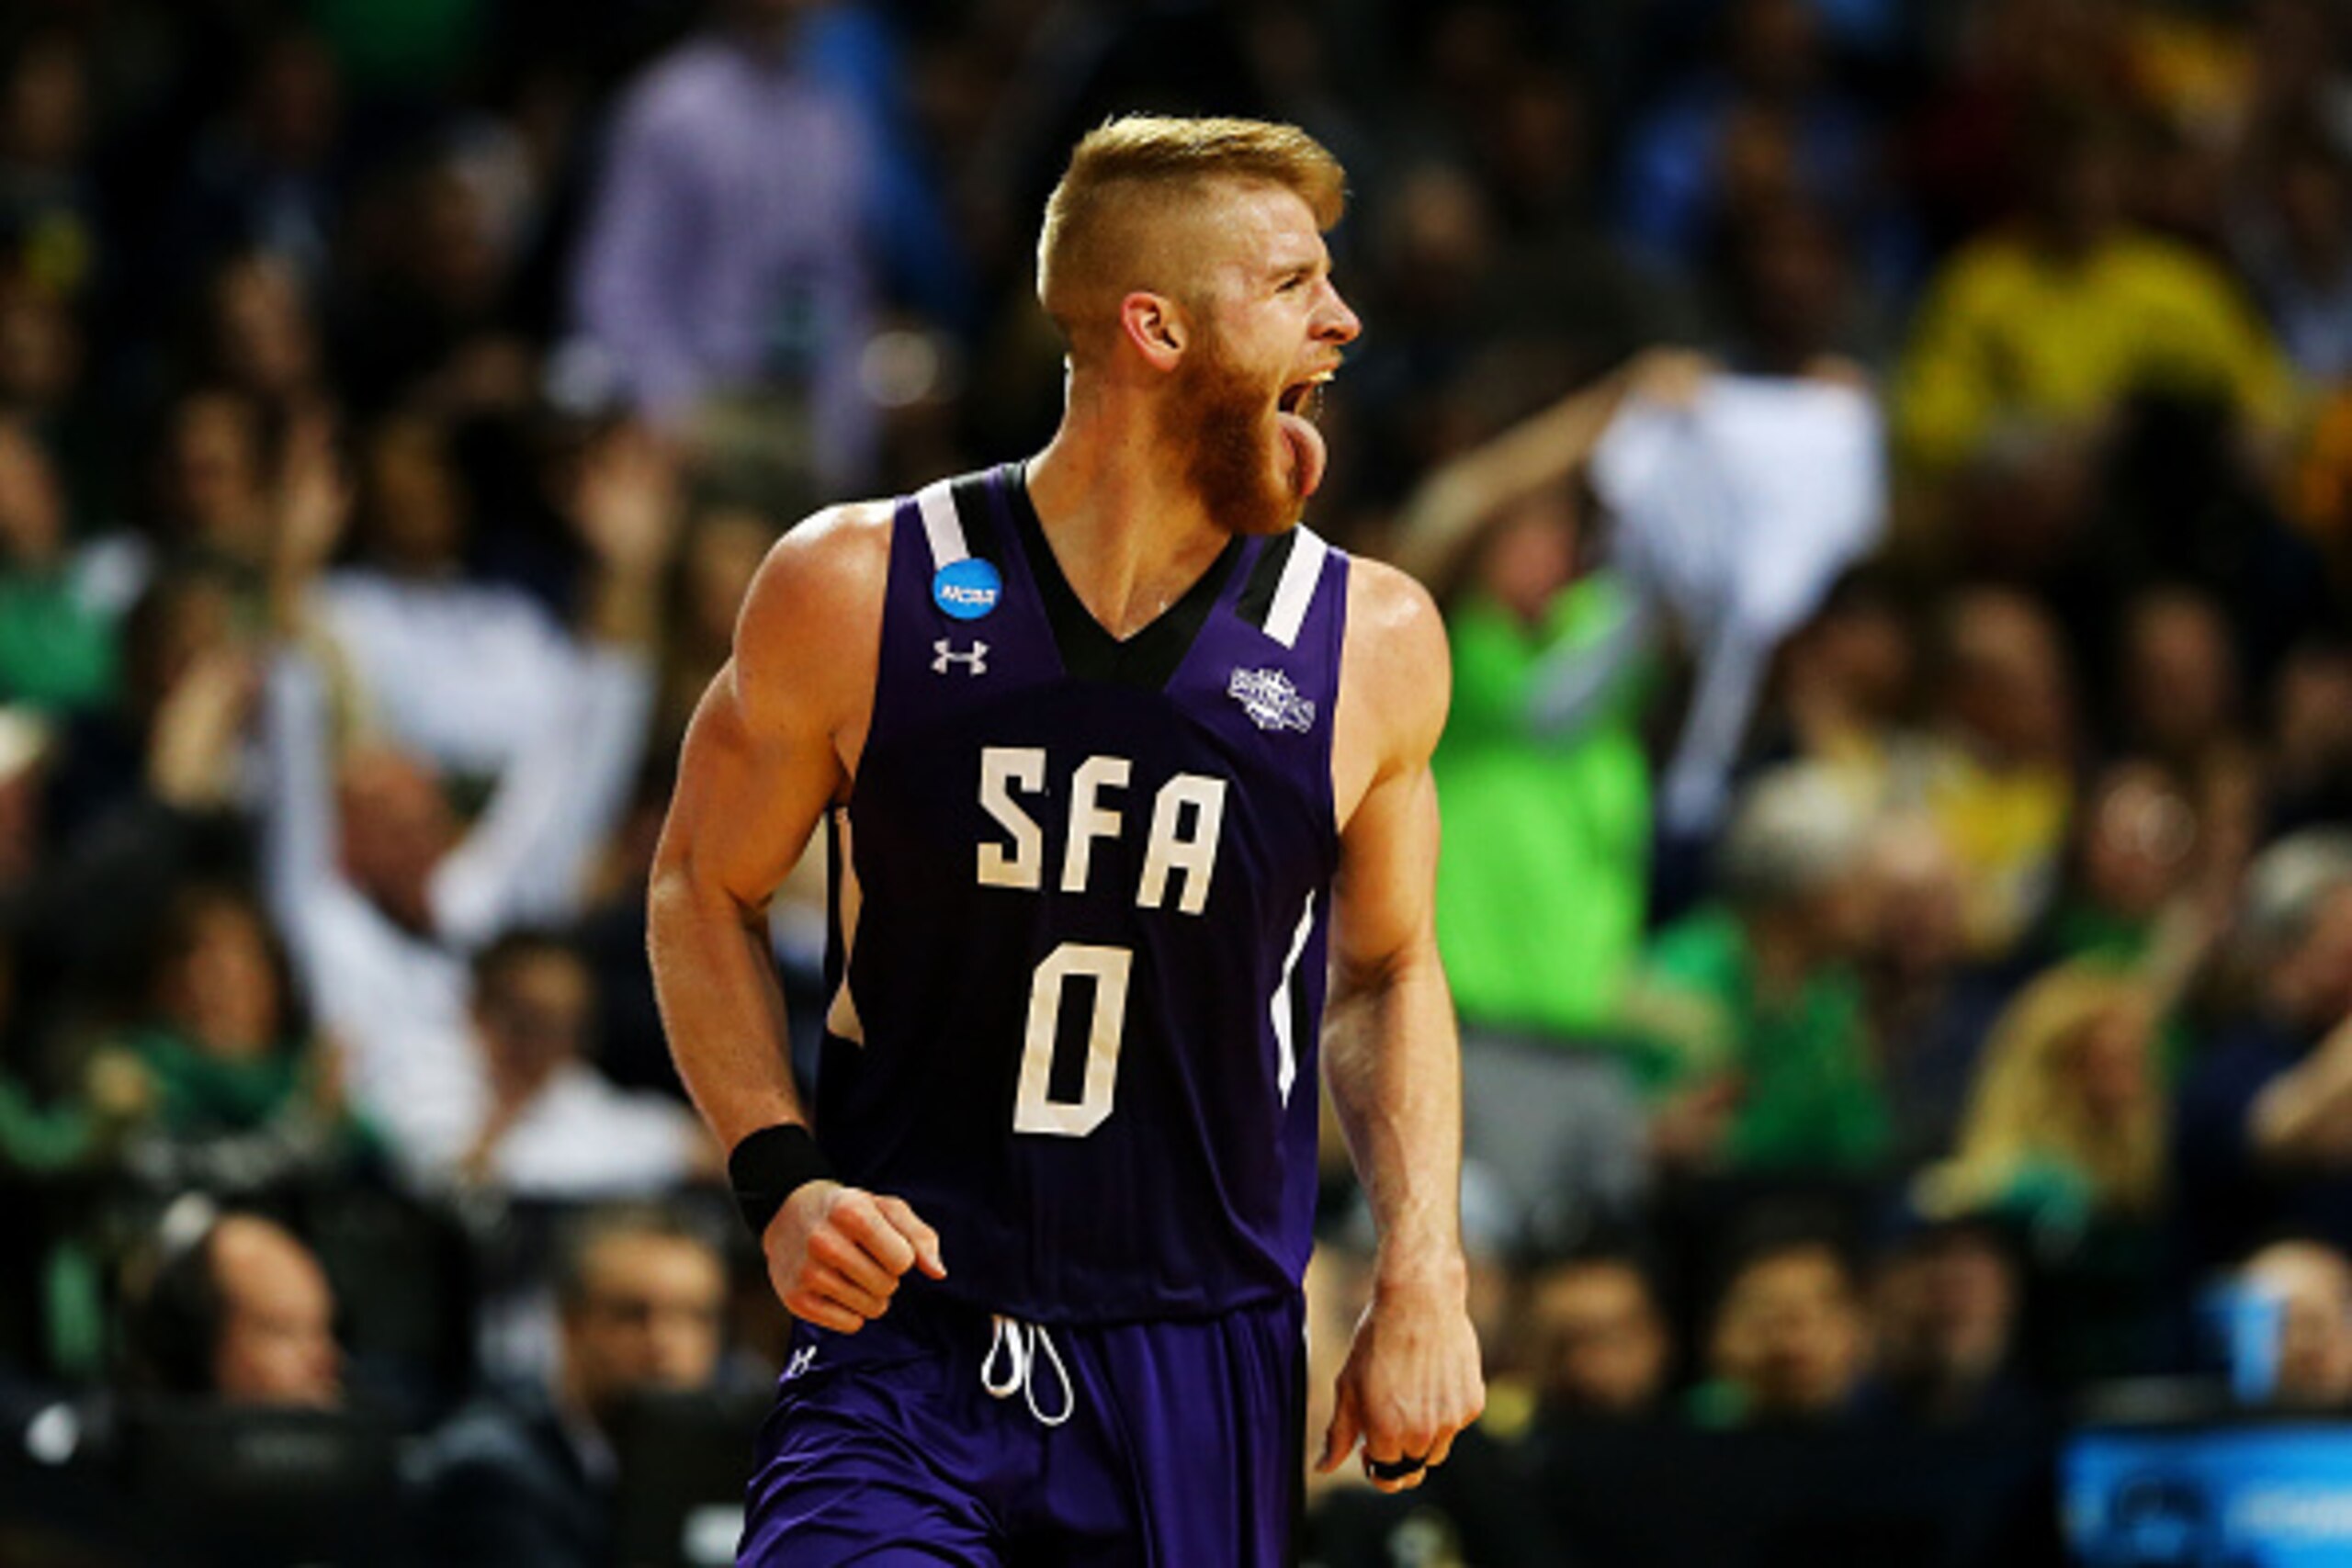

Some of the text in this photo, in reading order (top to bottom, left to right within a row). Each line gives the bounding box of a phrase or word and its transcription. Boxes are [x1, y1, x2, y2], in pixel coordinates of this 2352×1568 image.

[942, 585, 996, 606] NCAA
[977, 747, 1227, 916] SFA
[1012, 942, 1134, 1137] 0
